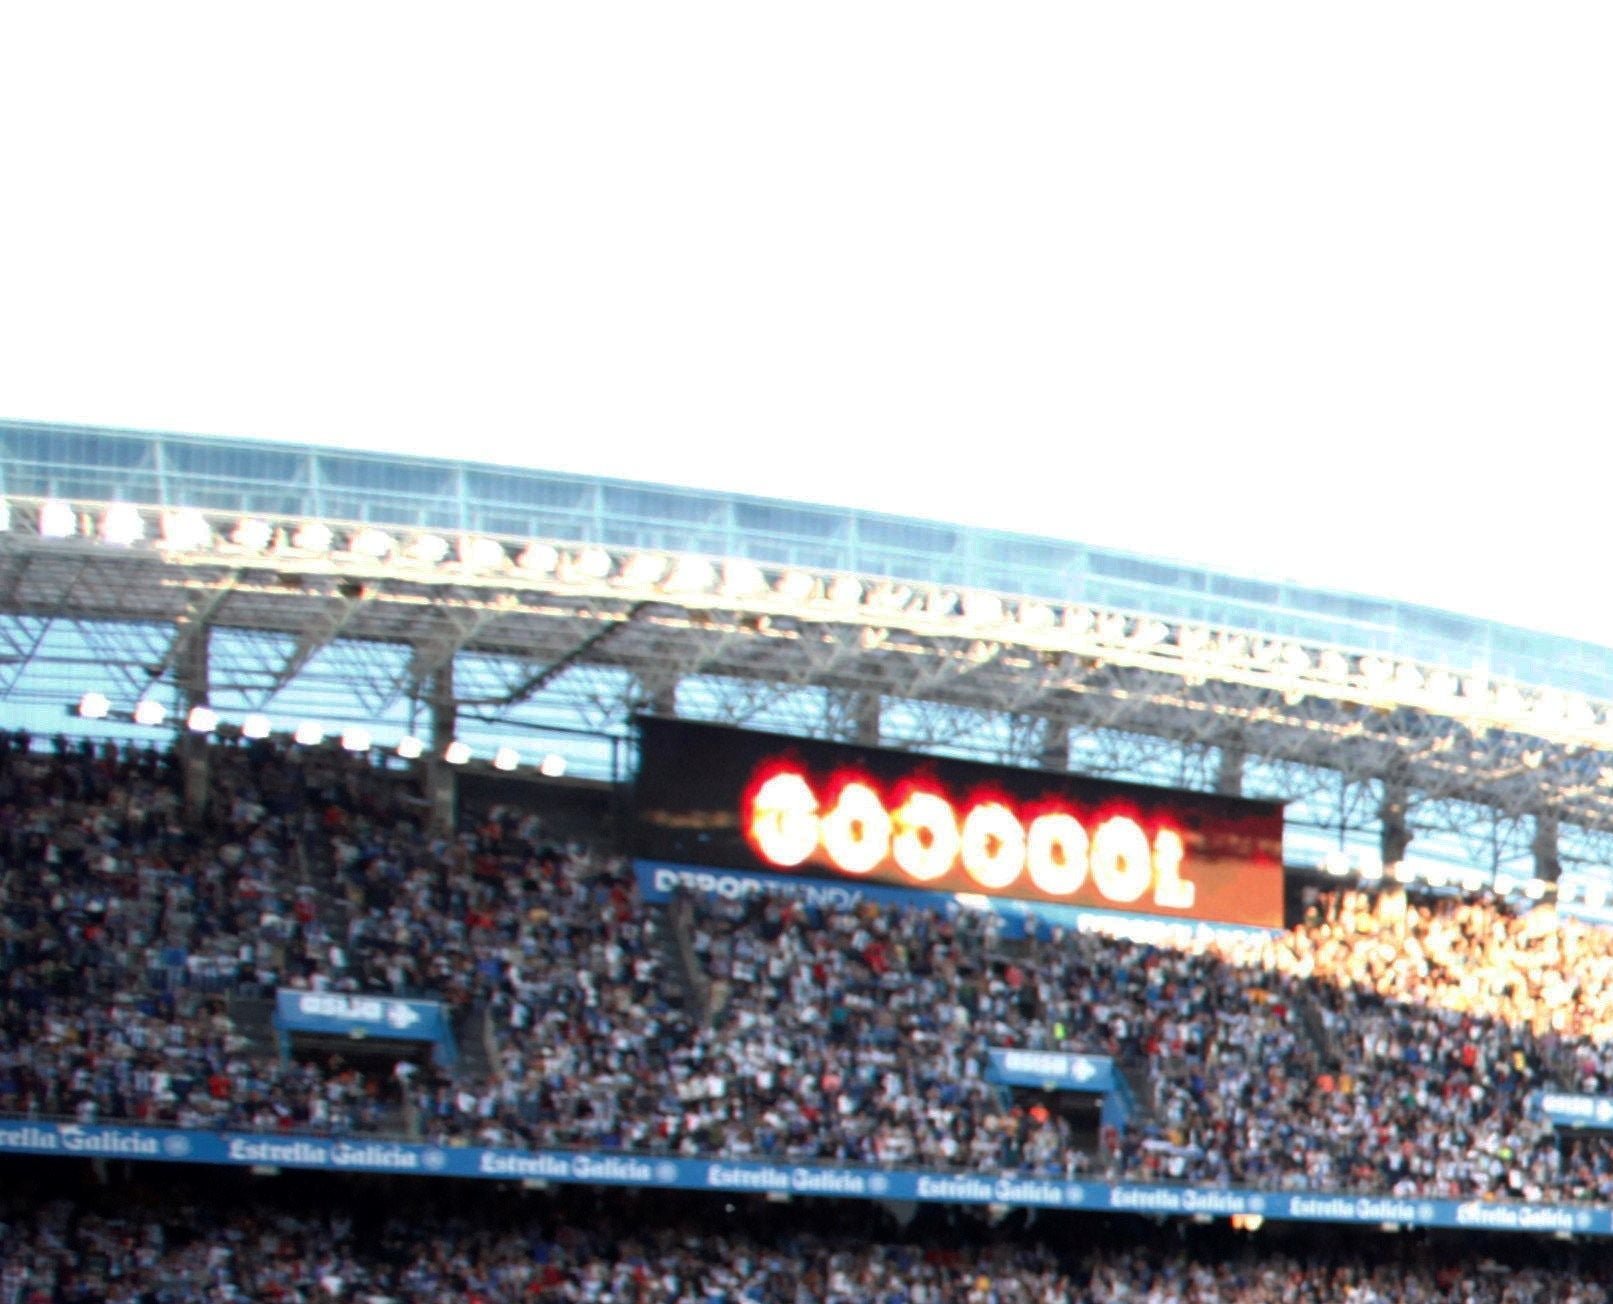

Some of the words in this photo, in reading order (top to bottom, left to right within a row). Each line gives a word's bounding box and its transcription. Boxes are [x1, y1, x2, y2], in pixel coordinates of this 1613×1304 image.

[0, 1127, 56, 1149] rella
[61, 1126, 159, 1153] Galicia
[228, 1138, 325, 1165] Estrella
[331, 1143, 417, 1167] Galicia
[481, 1152, 567, 1177] Estrella
[573, 1156, 651, 1181] Galicia
[708, 1164, 788, 1190] Estrella
[792, 1168, 865, 1193] Galicia
[918, 1176, 991, 1199] Estrella
[995, 1180, 1063, 1203] Galicia
[1110, 1186, 1179, 1208] Estrella
[1182, 1189, 1245, 1211] Galicia
